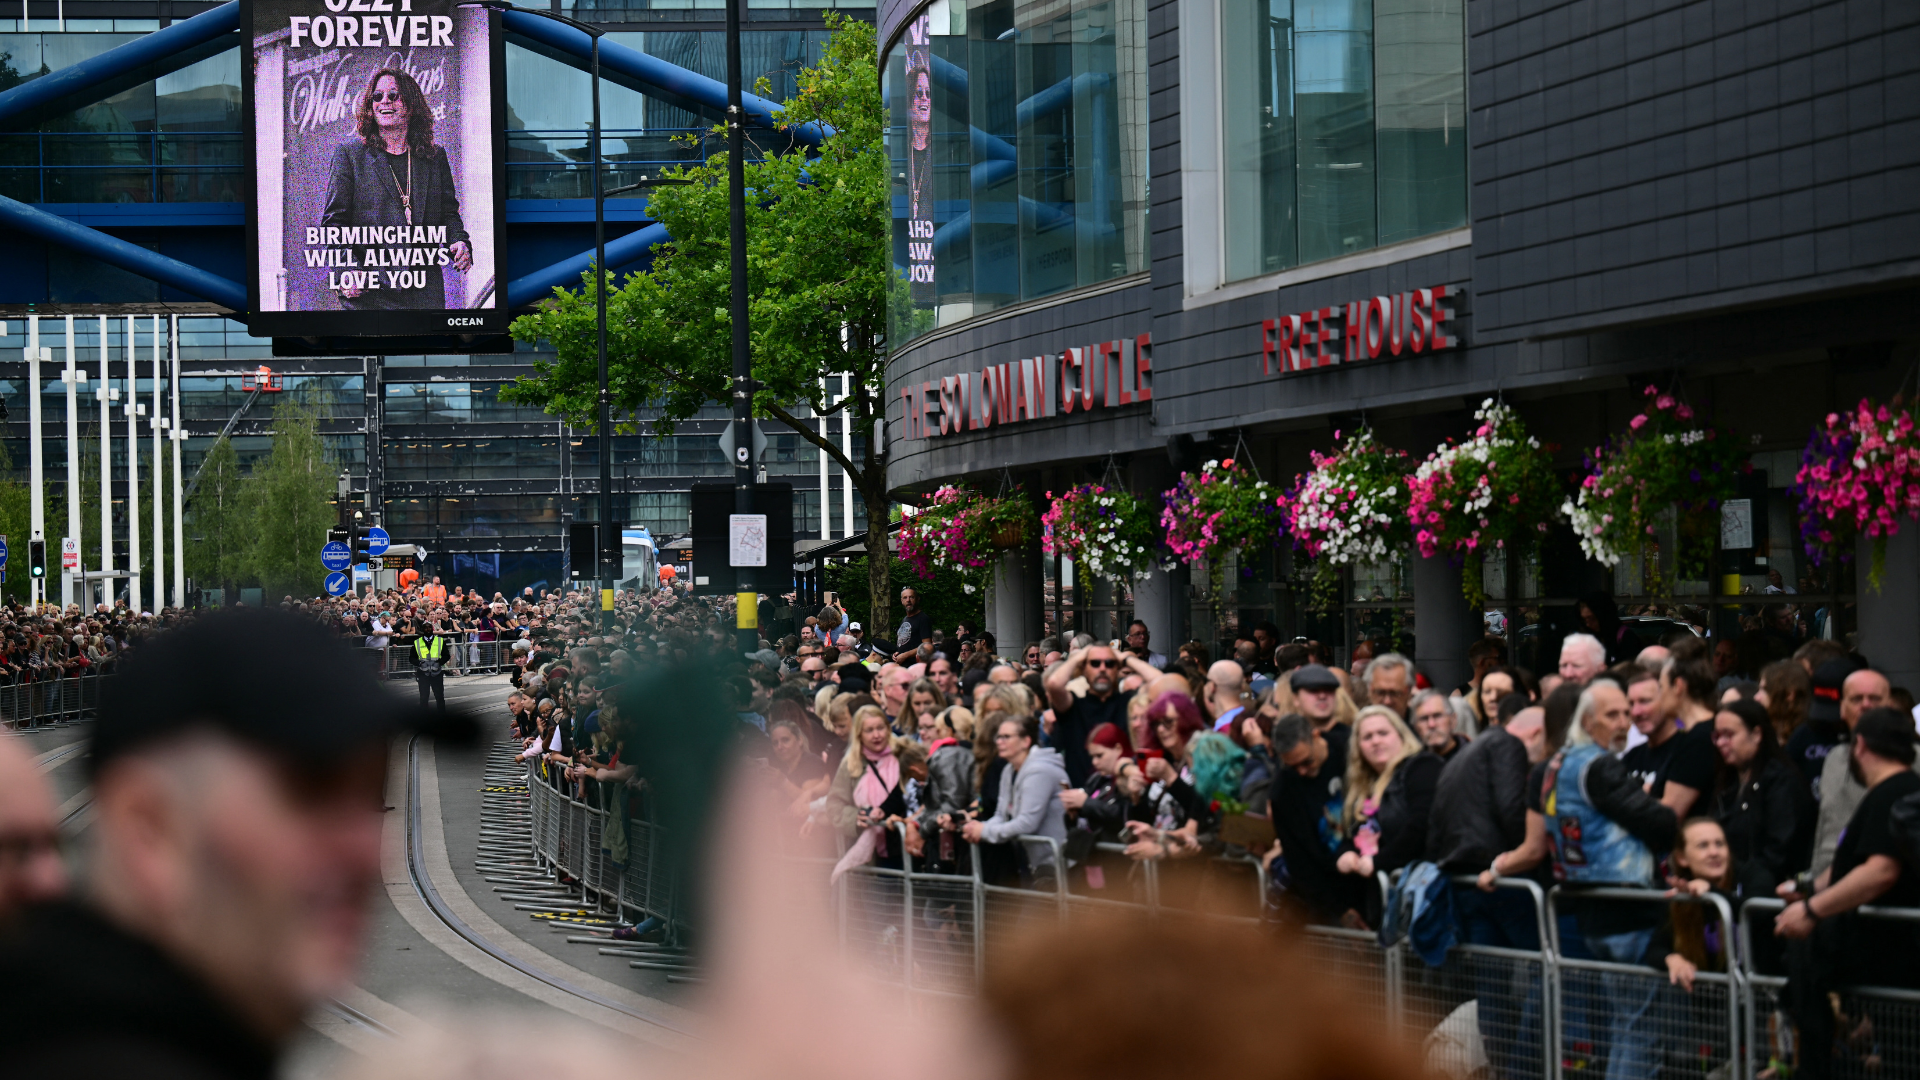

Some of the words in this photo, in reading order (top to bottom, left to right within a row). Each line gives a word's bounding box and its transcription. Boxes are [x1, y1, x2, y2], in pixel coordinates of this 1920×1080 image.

[289, 16, 454, 47] FOREVER
[306, 225, 447, 245] BIRMINGHAM
[304, 249, 358, 267] WILL
[363, 247, 450, 267] ALWAYS
[328, 270, 380, 290] LOVE
[386, 270, 427, 289] YOU
[447, 317, 484, 326] OCEAN
[1262, 306, 1340, 376] FREE
[1345, 285, 1458, 359] HOUSE
[901, 380, 940, 441] THE
[940, 354, 1056, 436] SOLOMAN
[1061, 331, 1153, 414] CUTLE
